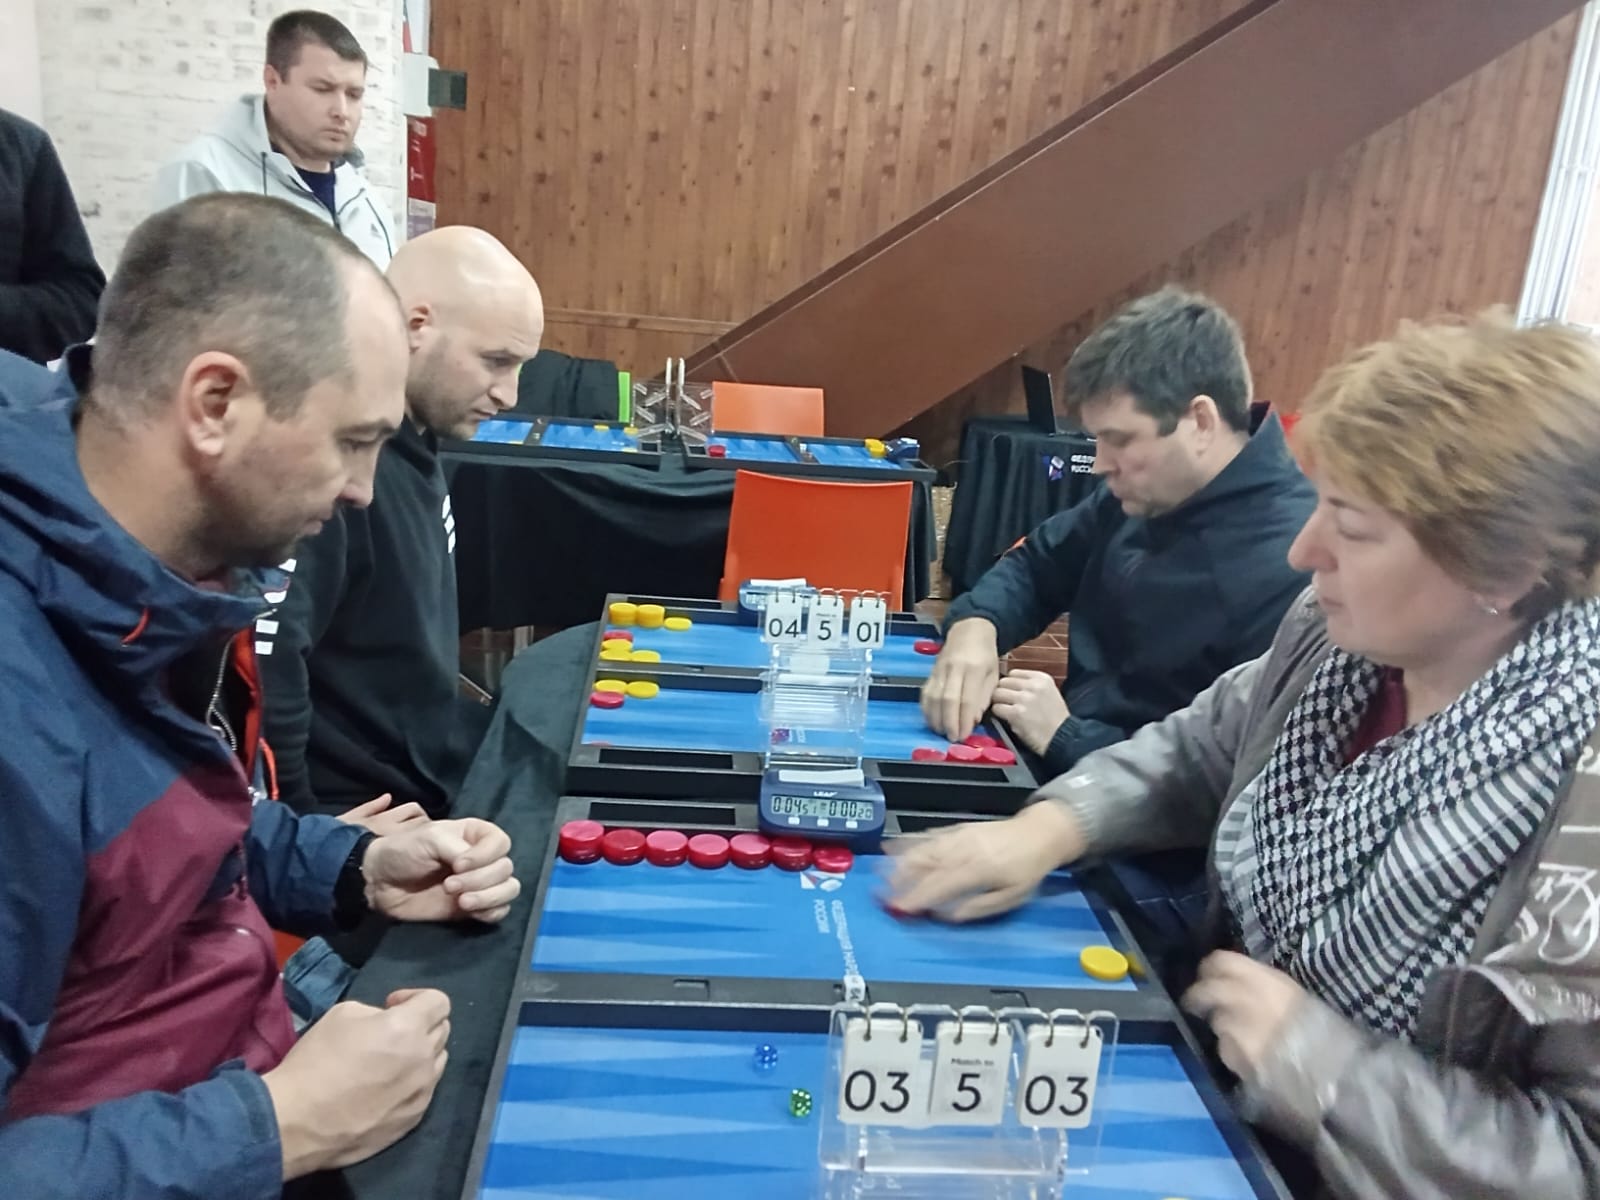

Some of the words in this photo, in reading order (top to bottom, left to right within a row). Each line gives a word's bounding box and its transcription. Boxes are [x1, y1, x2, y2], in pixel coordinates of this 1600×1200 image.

[769, 618, 799, 638] 04
[818, 620, 832, 640] 5
[856, 622, 881, 643] 01
[844, 1069, 910, 1113] 03
[951, 1072, 981, 1112] 5
[1025, 1075, 1089, 1116] 03
